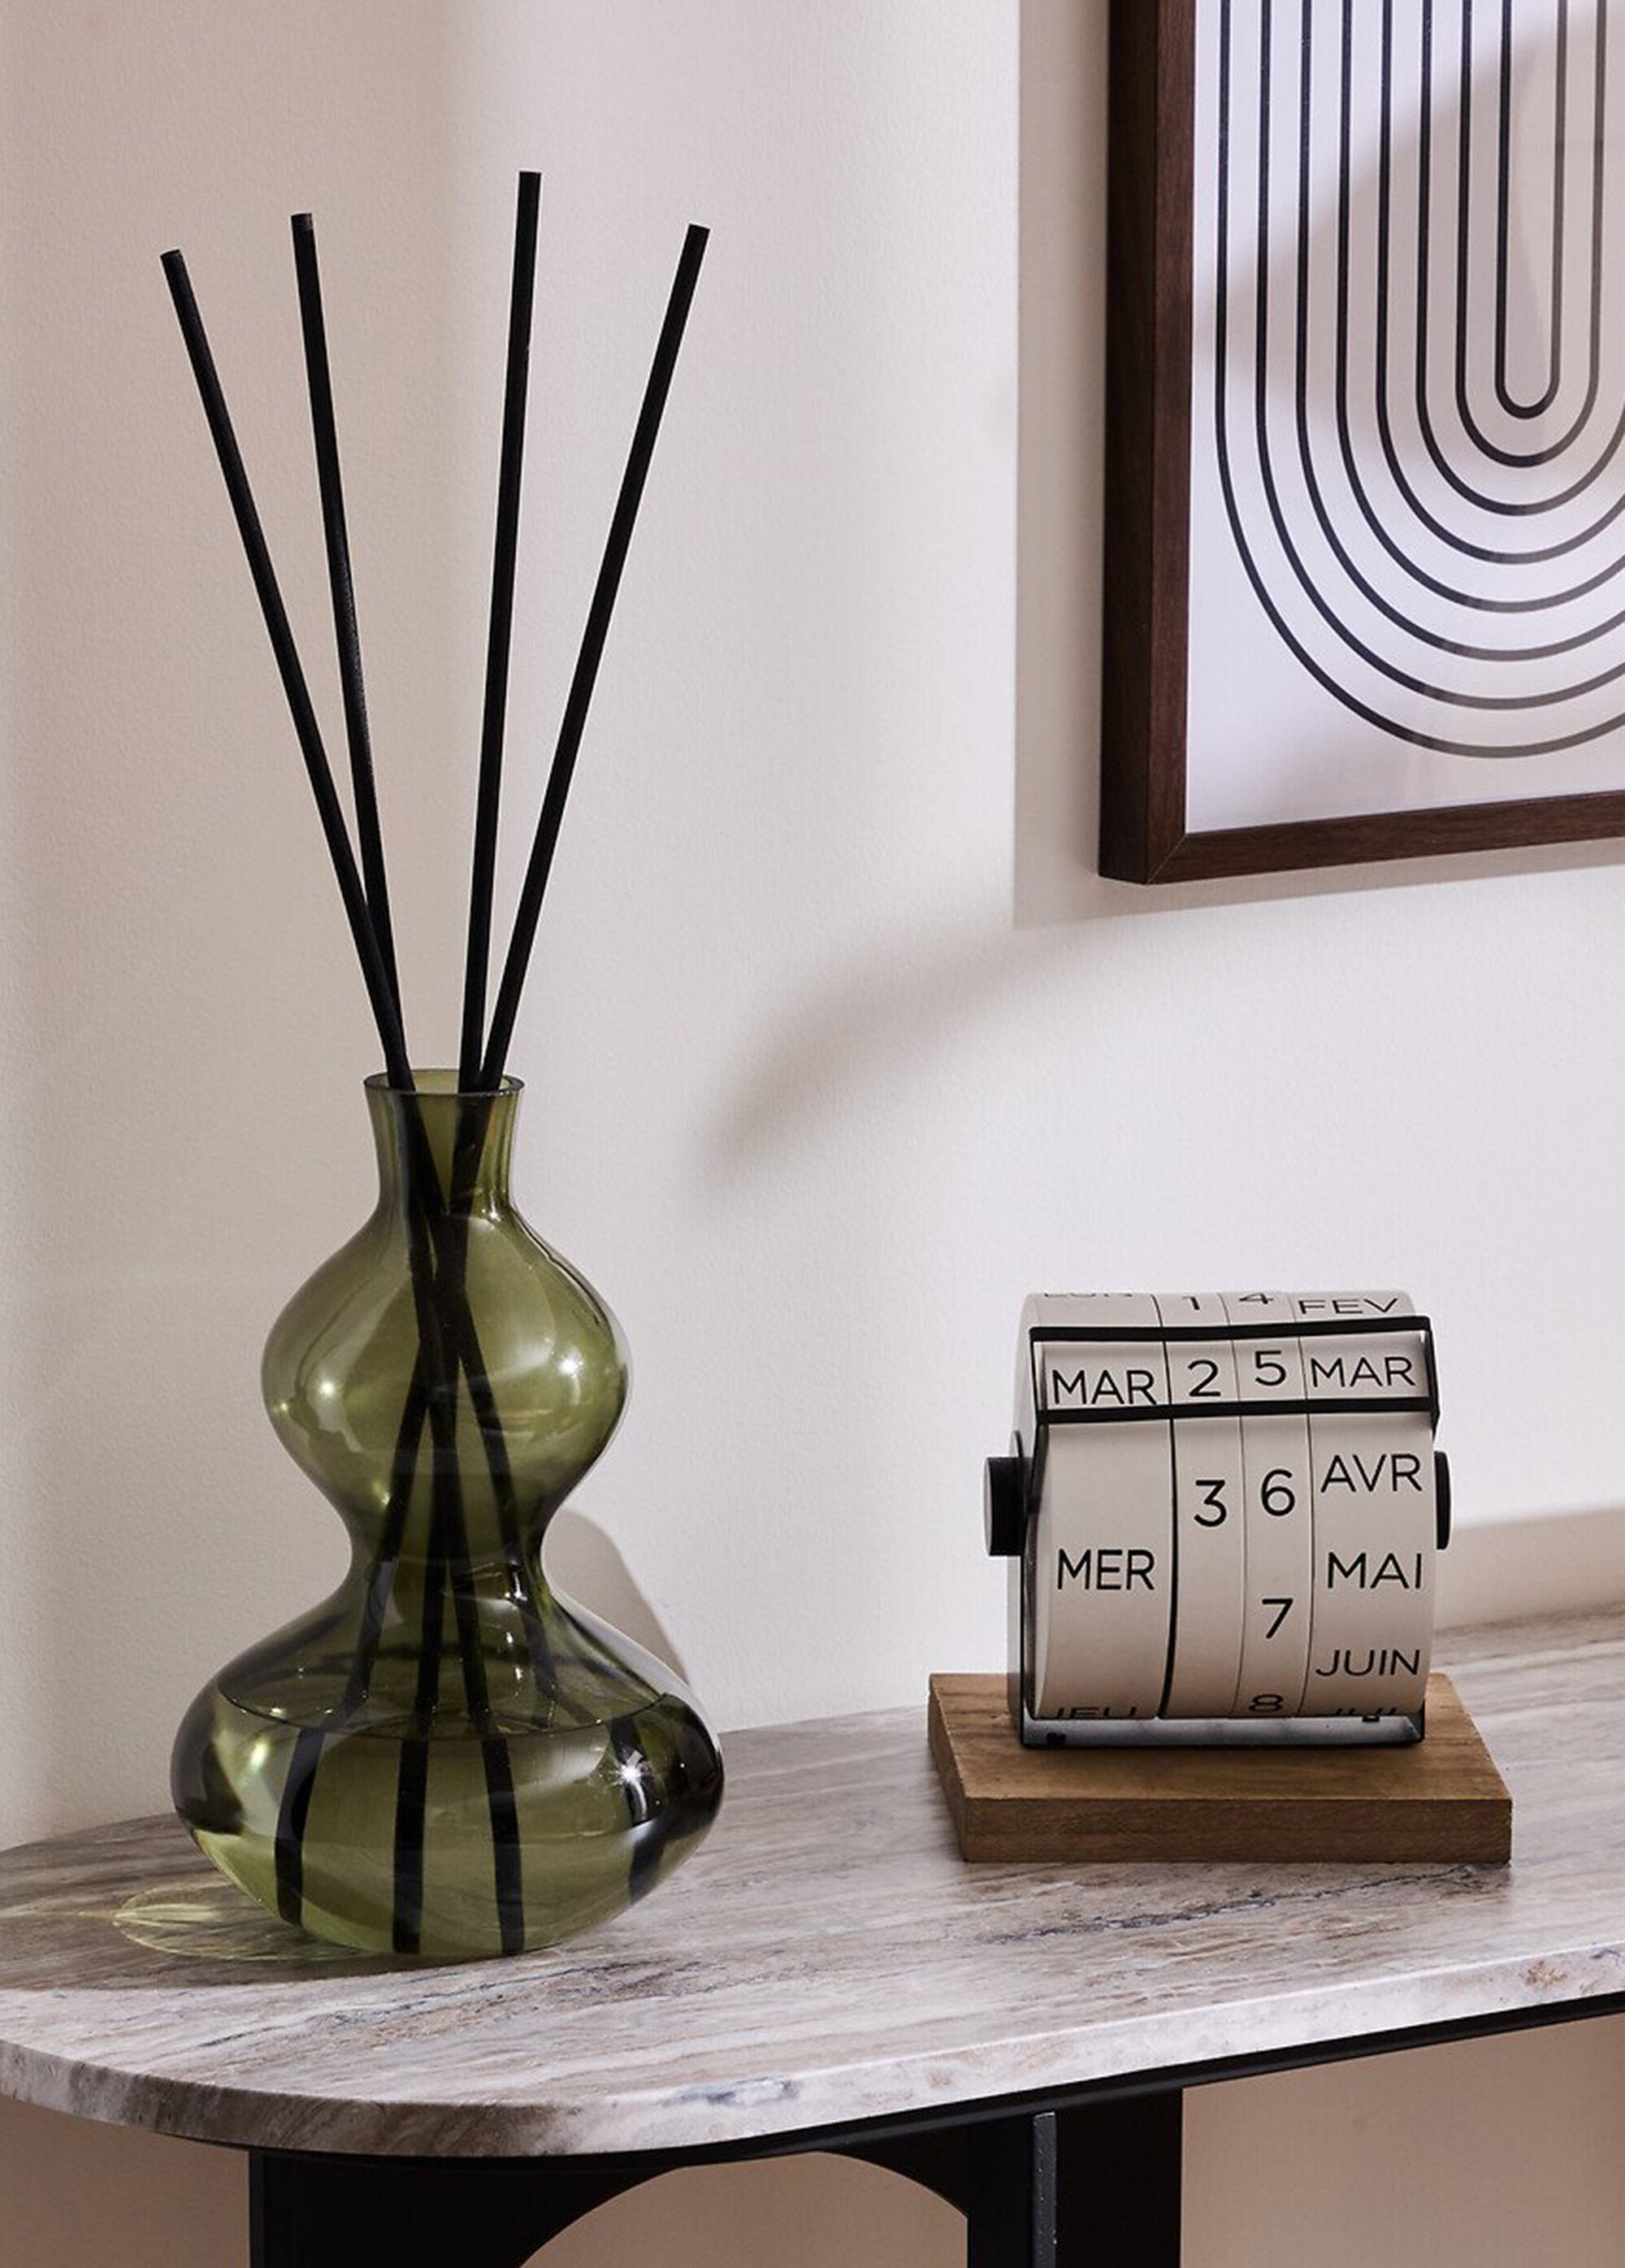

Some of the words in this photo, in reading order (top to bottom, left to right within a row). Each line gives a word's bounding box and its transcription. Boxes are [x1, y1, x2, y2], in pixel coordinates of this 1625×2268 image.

[1298, 1298, 1398, 1315] FEV
[1051, 1369, 1157, 1405] MAR
[1187, 1359, 1221, 1398] 2
[1254, 1350, 1287, 1386] 5
[1310, 1356, 1416, 1388] MAR
[1194, 1479, 1228, 1528] 3
[1260, 1468, 1296, 1517] 6
[1320, 1453, 1423, 1494] AVR
[1057, 1548, 1155, 1590] MER
[1327, 1552, 1423, 1589] MAI
[1261, 1598, 1294, 1640] 7
[1315, 1649, 1421, 1676] JUIN
[1248, 1693, 1284, 1712] 8
